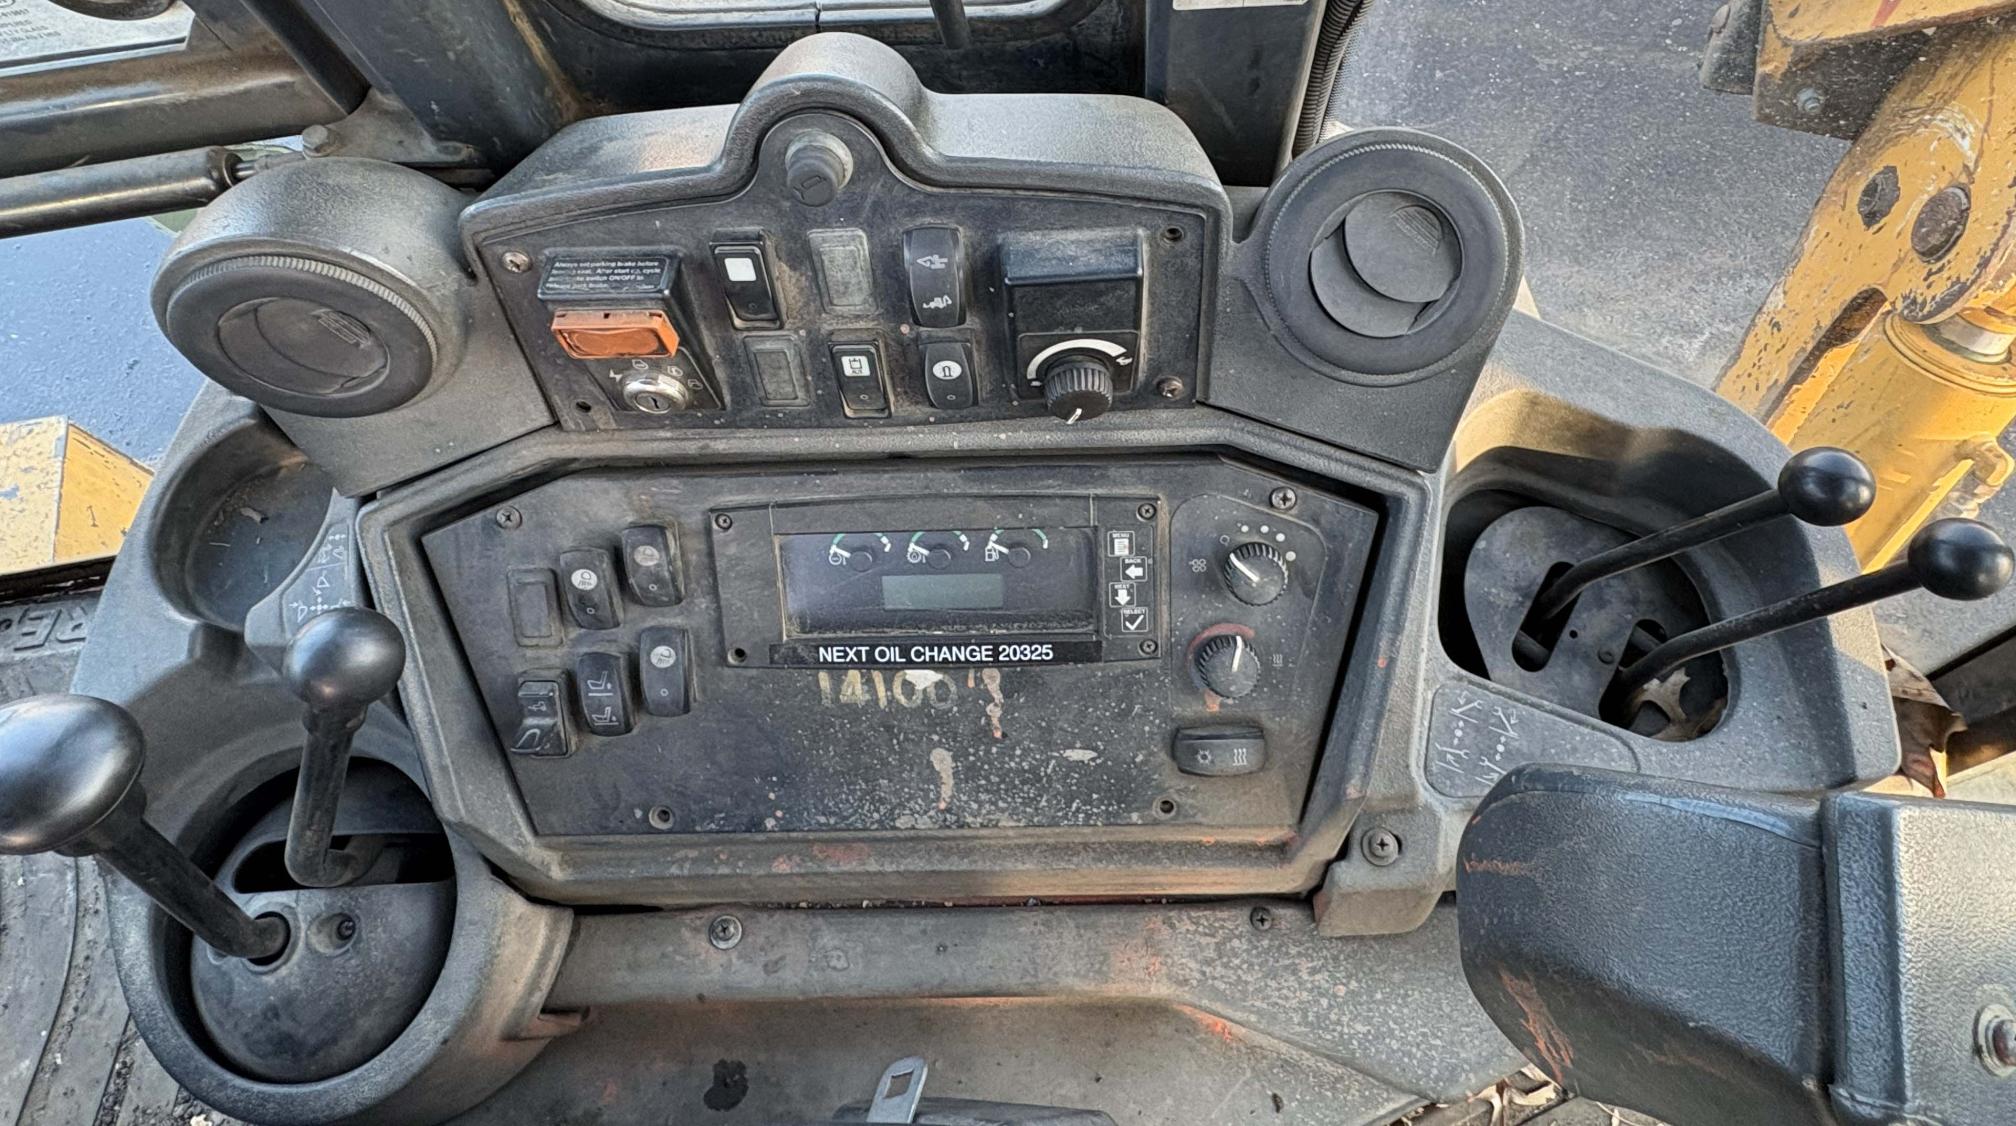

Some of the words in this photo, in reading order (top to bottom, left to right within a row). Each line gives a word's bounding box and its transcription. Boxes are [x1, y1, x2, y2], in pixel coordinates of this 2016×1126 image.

[818, 646, 870, 663] NEXT
[874, 646, 906, 662] OIL
[910, 645, 994, 662] CHANGE
[998, 644, 1054, 661] 20325
